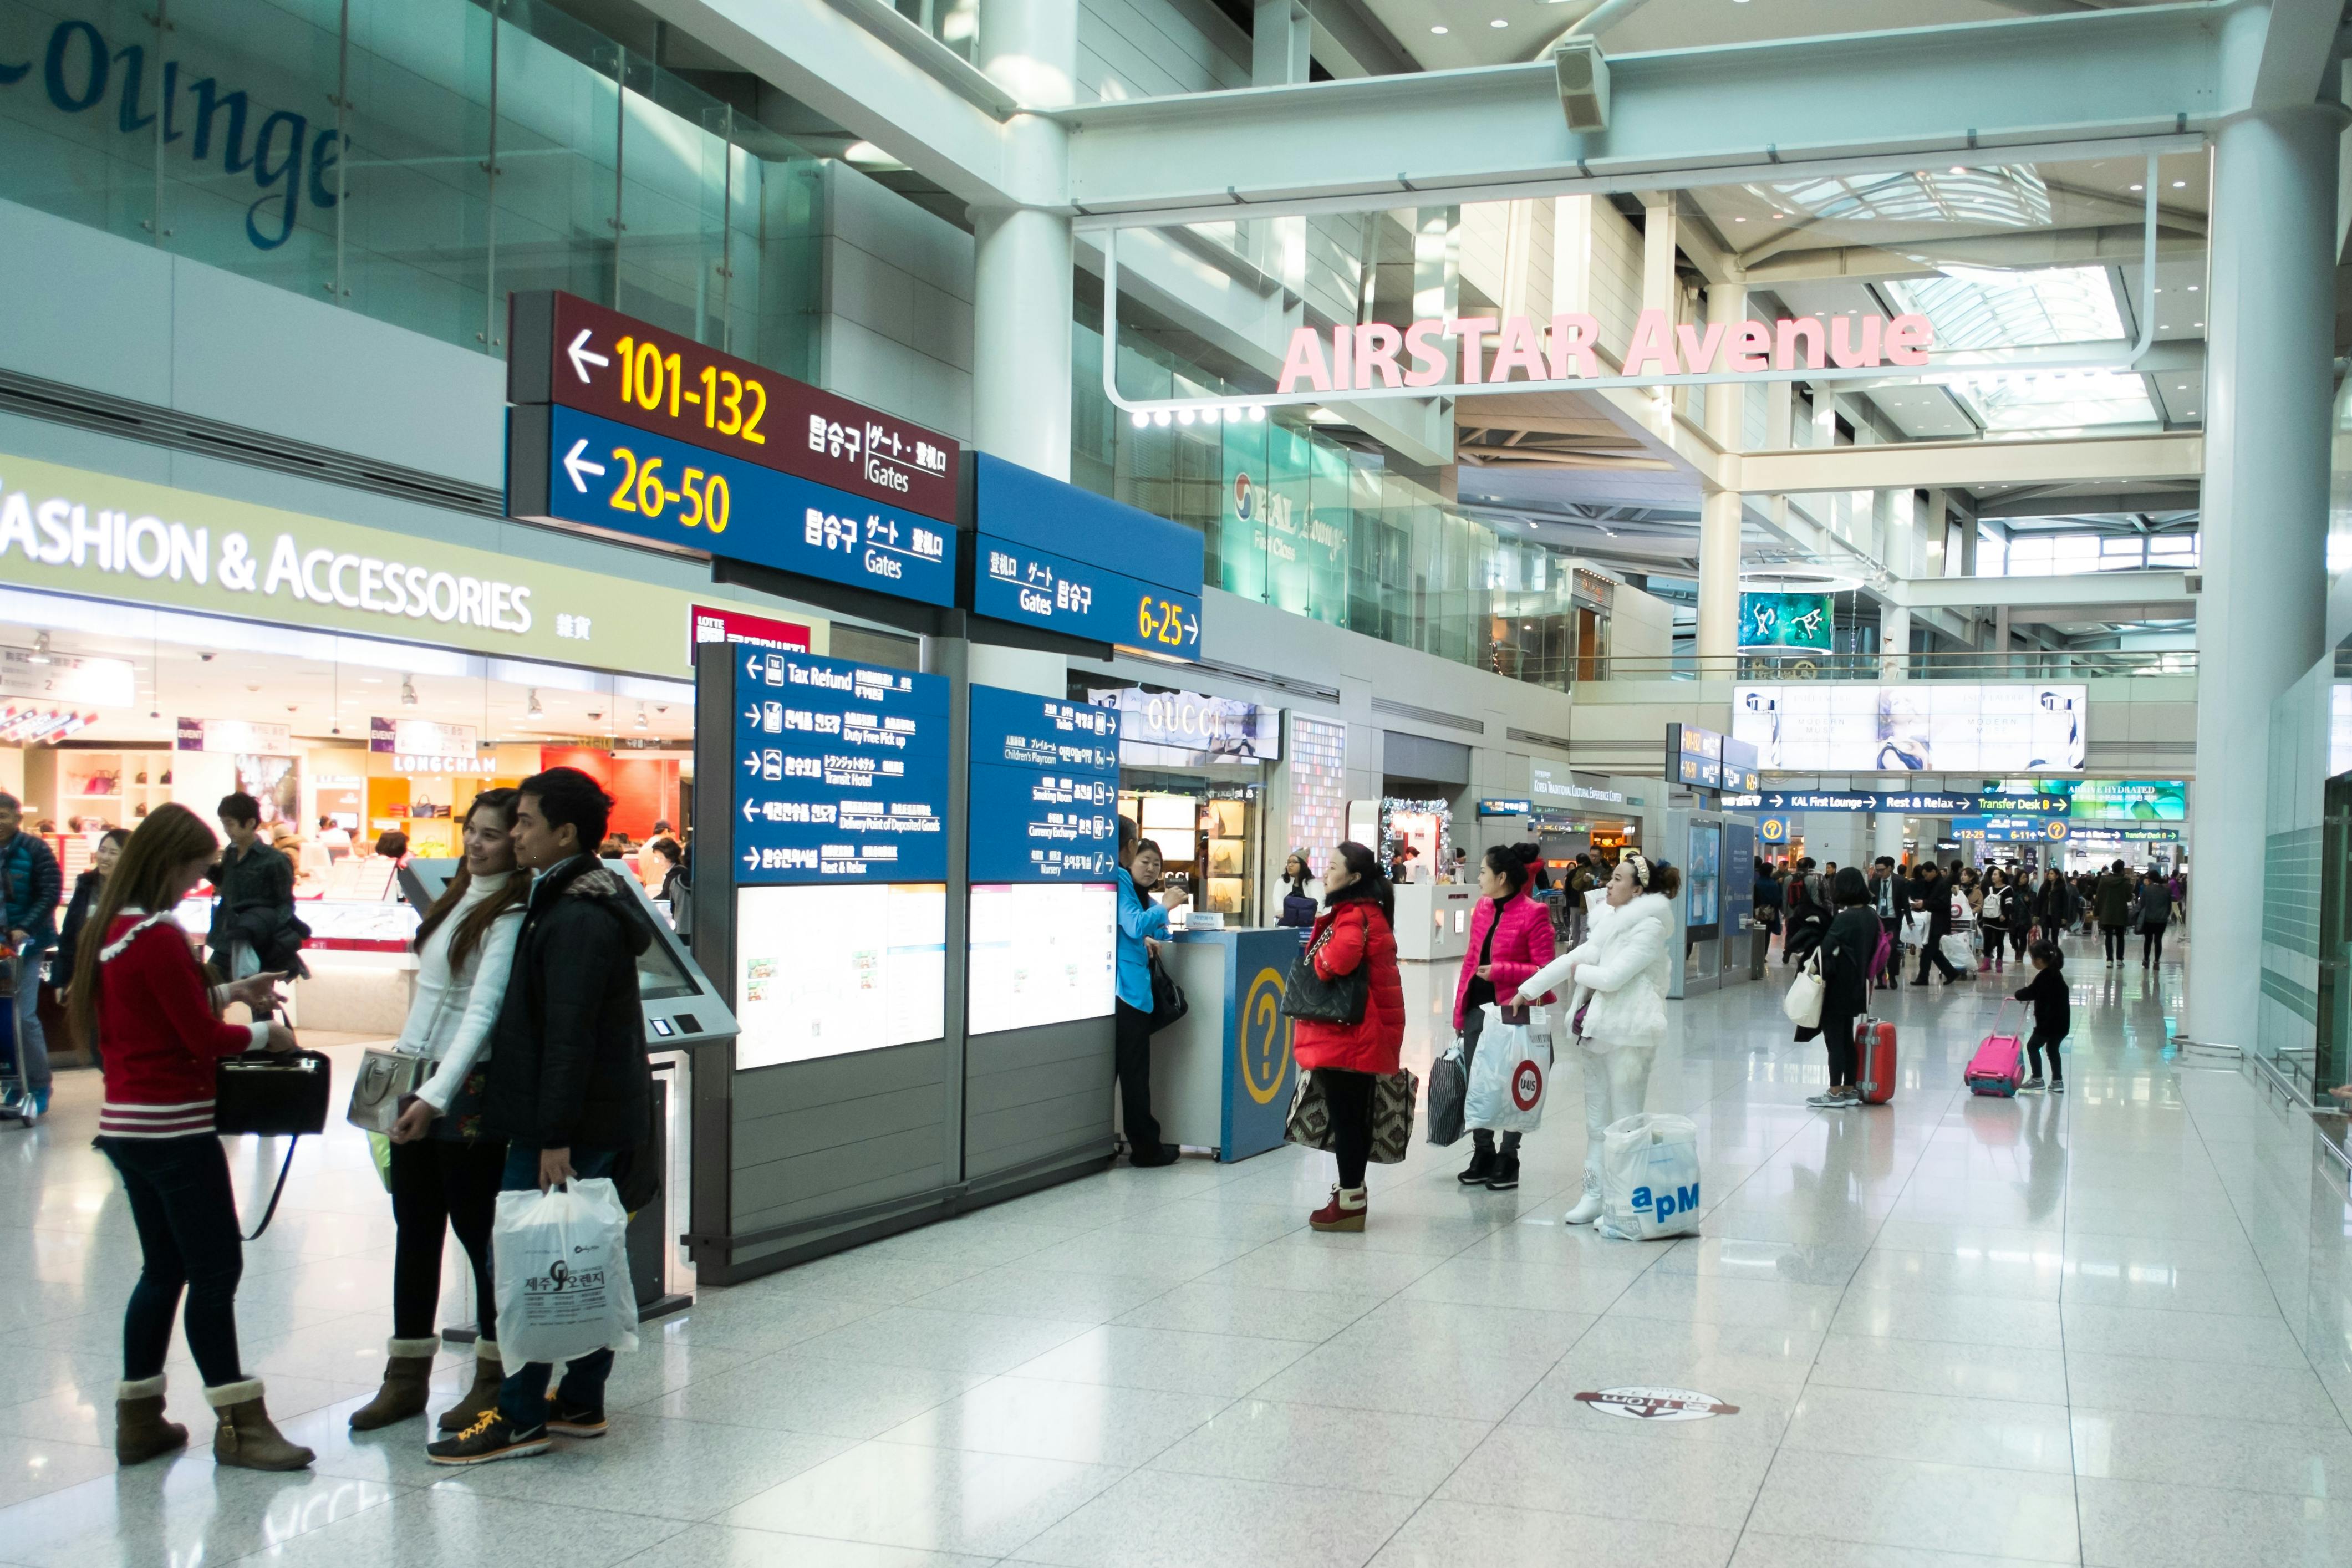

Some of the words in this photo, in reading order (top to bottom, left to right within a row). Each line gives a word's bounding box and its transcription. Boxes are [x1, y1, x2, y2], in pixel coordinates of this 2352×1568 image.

[0, 20, 350, 251] ounge
[1277, 312, 1600, 394] AIRSTAR
[1622, 308, 1933, 378] Avenue
[616, 336, 767, 444] 101-132
[809, 414, 861, 462] 탑승구
[868, 459, 908, 492] Gates
[610, 448, 730, 534] 26-50
[1254, 486, 1296, 535] KAL
[806, 508, 857, 553] 탑승구
[866, 515, 898, 544] ゲート
[0, 478, 208, 586] ASHION
[218, 533, 256, 592] &
[264, 534, 532, 636] ACCESSORIES
[864, 549, 902, 579] Gates
[1028, 562, 1052, 587] ゲート
[1020, 589, 1052, 616] Gates
[1057, 579, 1091, 614] 탑승구
[697, 616, 724, 629] LOTTE
[1139, 596, 1182, 646] 6-25
[788, 664, 809, 685] Tax
[811, 667, 852, 691] Refund
[1149, 699, 1219, 737] GUCCI
[179, 729, 203, 740] EVENT
[371, 730, 395, 741] EVENT
[843, 727, 862, 745] Duty
[863, 730, 880, 744] Free
[880, 732, 894, 746] Pick
[895, 735, 905, 749] up
[1005, 749, 1031, 762] Children's
[1032, 752, 1056, 766] Playroom
[825, 771, 851, 786] Transit
[852, 773, 873, 787] Hotel
[1534, 780, 1547, 792] KOREA
[1548, 781, 1571, 796] TRADITIONAL
[1572, 785, 1589, 798] CULTURAL
[1590, 787, 1608, 802] EXPERIENCE
[1609, 789, 1622, 802] CENTER
[1033, 789, 1056, 804] Smoking
[1057, 791, 1072, 803] Room
[1791, 797, 1809, 807] KAL
[1810, 797, 1829, 807] First
[1830, 797, 1862, 810] Lounge
[1886, 797, 1911, 807] Rest
[1912, 798, 1921, 808] &
[1923, 797, 1954, 808] Relax
[1978, 798, 2016, 810] Transfer
[2018, 798, 2040, 810] Desk
[839, 817, 866, 832] Delivery
[866, 818, 883, 831] Point
[884, 818, 890, 831] of
[891, 818, 921, 833] Deposited
[922, 819, 940, 832] Goods
[1029, 826, 1053, 839] Currency
[1053, 827, 1077, 841] Exchange
[1961, 831, 1985, 839] 12-25
[821, 861, 837, 874] Rest
[838, 862, 846, 874] &
[846, 861, 867, 874] Relax
[1041, 864, 1061, 877] Nursery
[1632, 1182, 1699, 1223] apM
[525, 1277, 551, 1291] 제주
[568, 1271, 605, 1289] 오렌지
